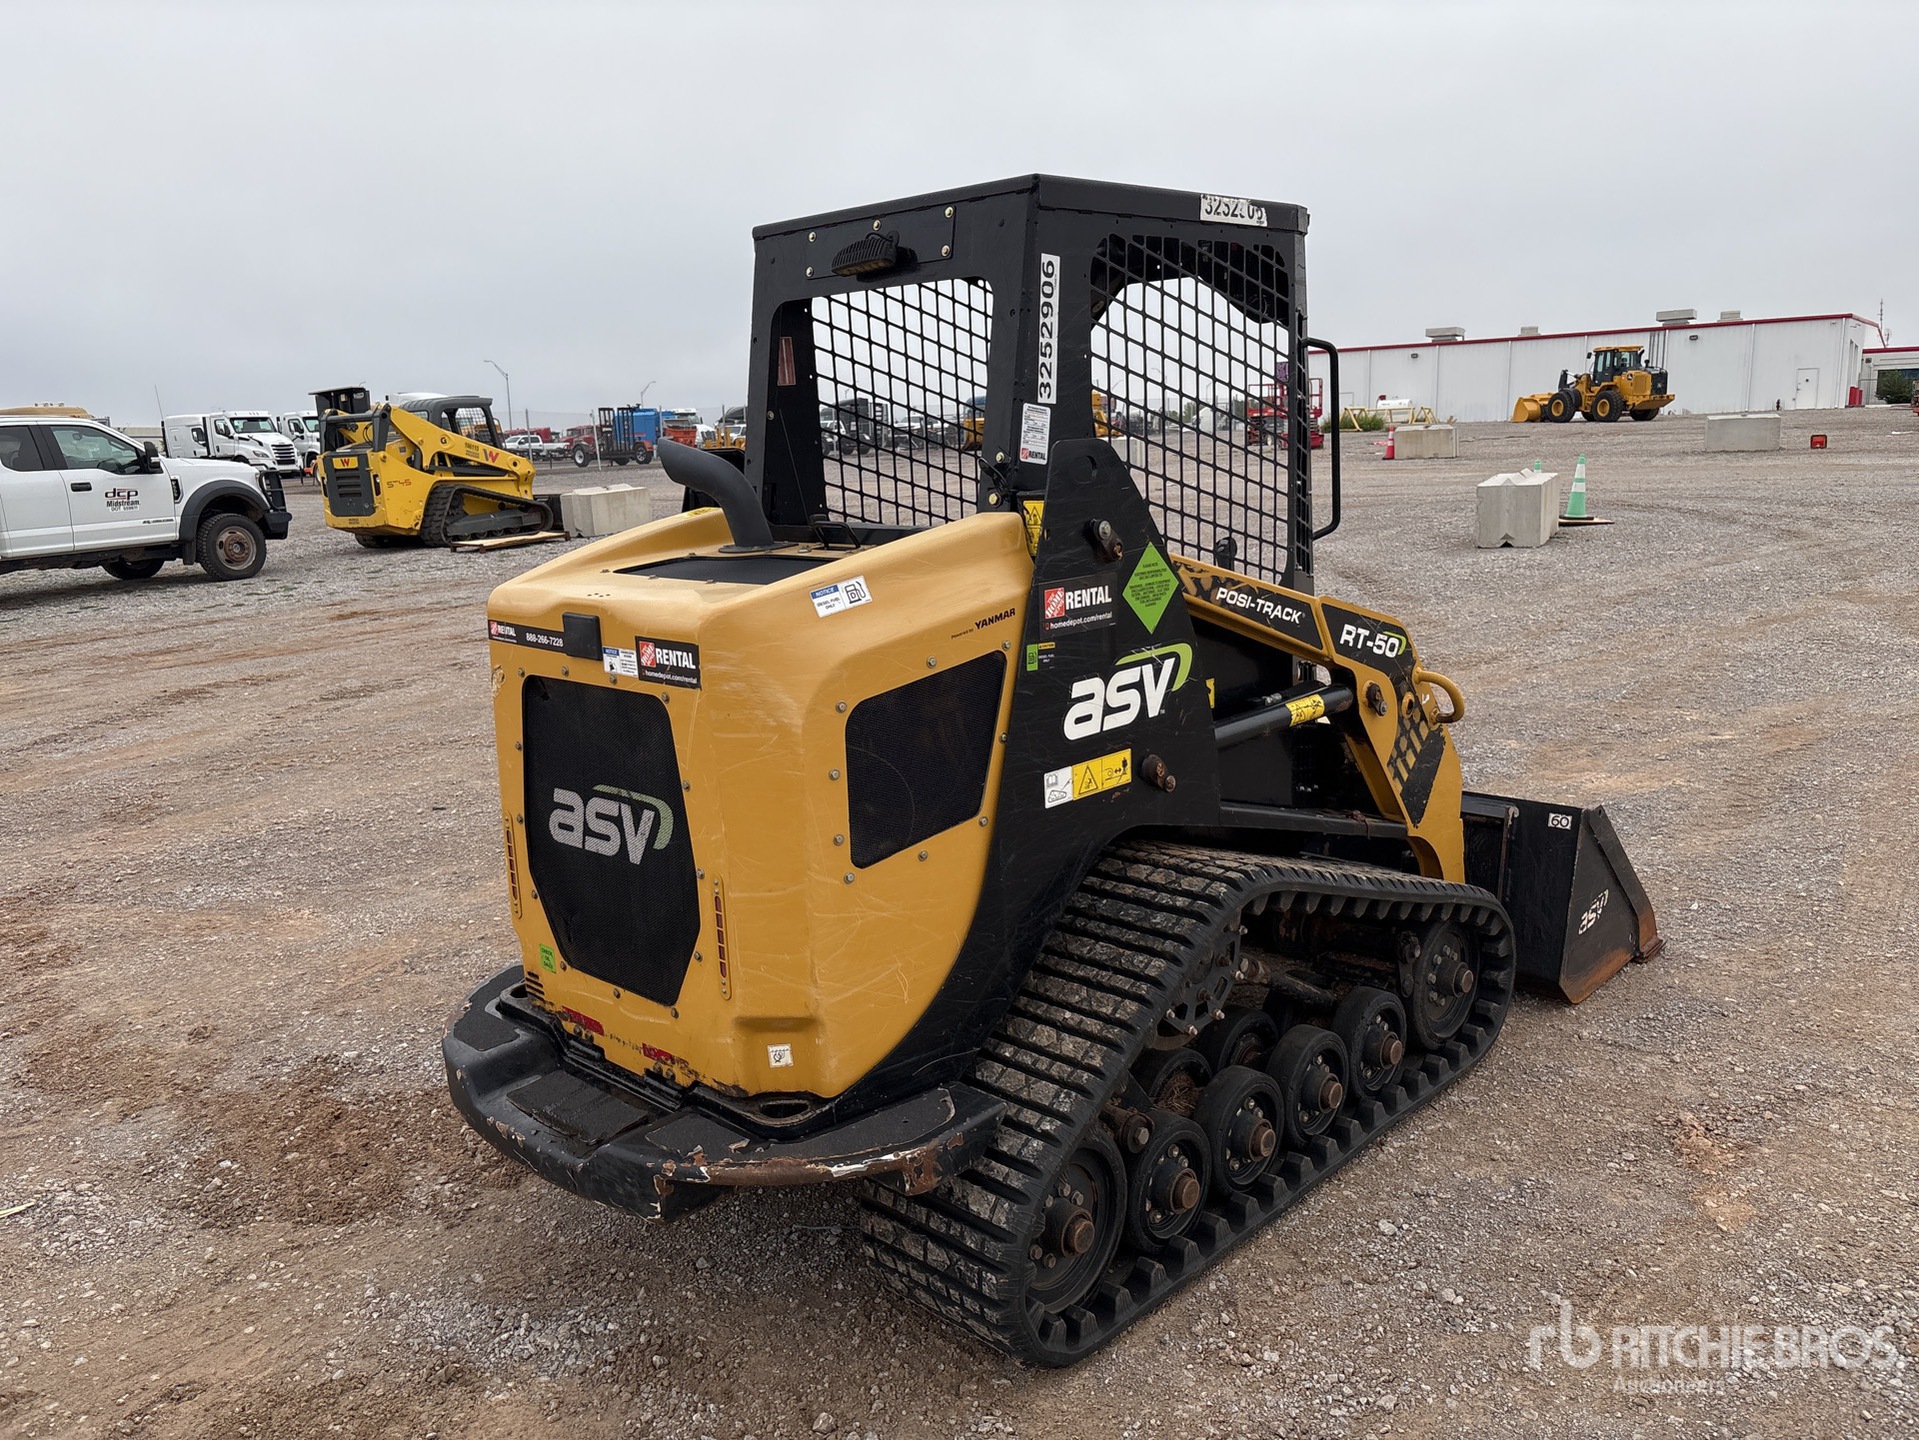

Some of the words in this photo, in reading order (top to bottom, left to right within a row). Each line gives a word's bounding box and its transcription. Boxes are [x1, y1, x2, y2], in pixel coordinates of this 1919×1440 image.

[1039, 260, 1055, 399] 3252906
[1029, 450, 1046, 460] RENTAL
[104, 488, 138, 500] dcp
[1065, 585, 1112, 610] RENTAL
[1216, 587, 1302, 624] POSI-TRACK
[975, 607, 1016, 630] YANMAR
[1050, 611, 1113, 630] homedepot.com/rental
[498, 625, 516, 636] RENTAL
[951, 629, 969, 639] Powered
[1339, 624, 1399, 658] RT-50
[656, 648, 696, 669] RENTAL
[645, 670, 697, 684] homedepot.com/rental
[1064, 657, 1176, 741] asv
[549, 787, 655, 865] asv
[1551, 815, 1570, 828] 60
